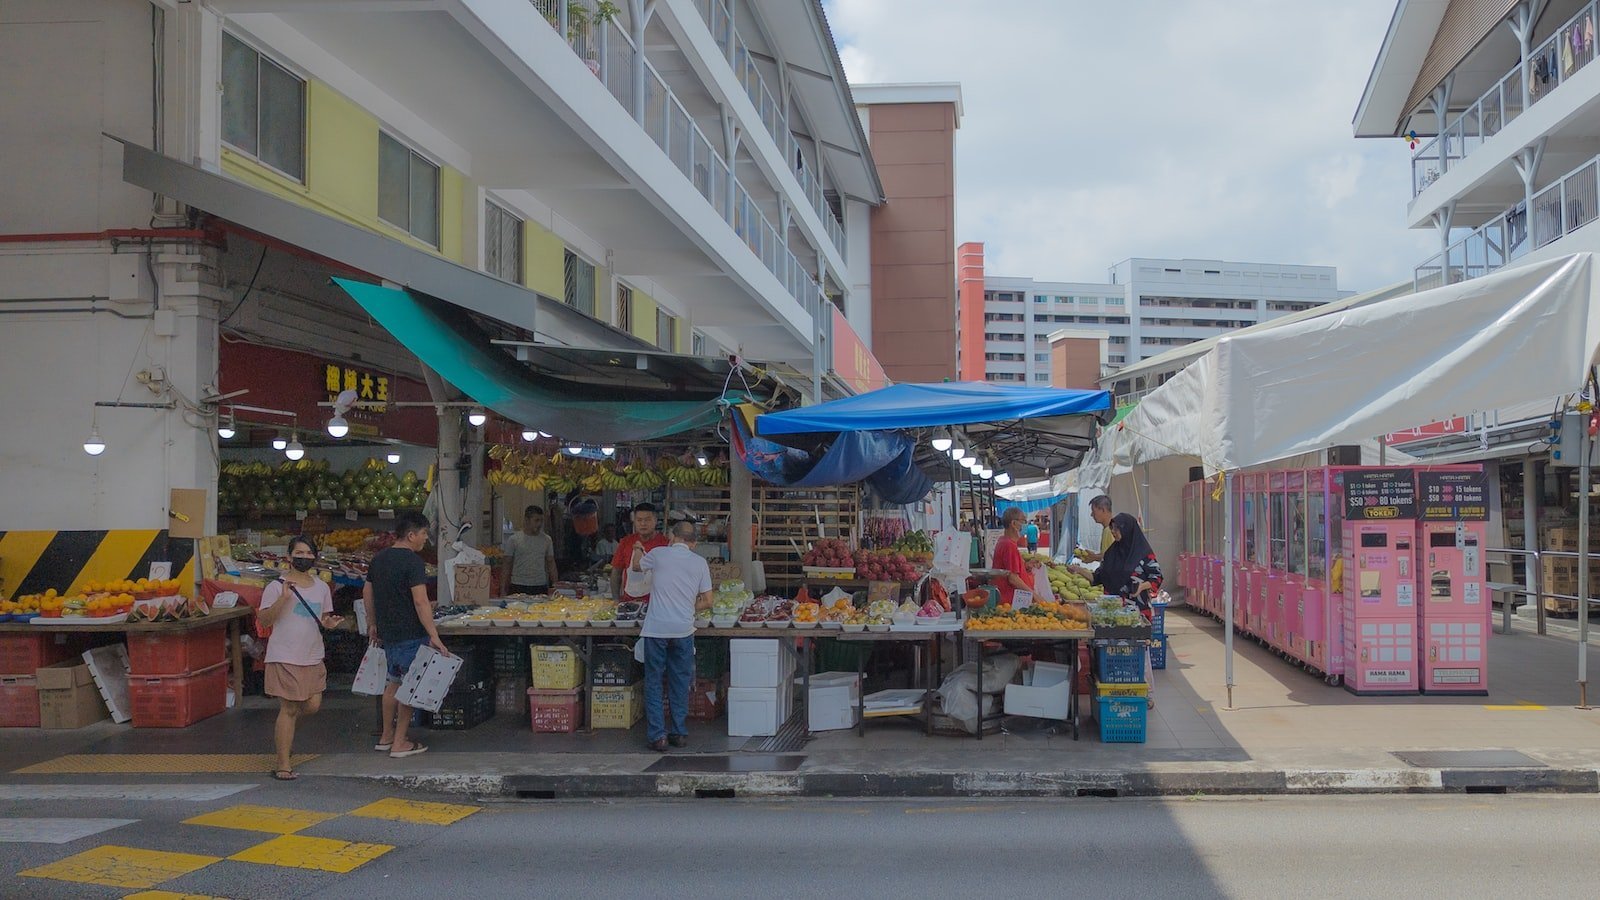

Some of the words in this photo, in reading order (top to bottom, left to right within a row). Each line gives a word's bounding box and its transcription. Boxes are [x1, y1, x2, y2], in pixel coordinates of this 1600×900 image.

[1428, 485, 1439, 493] $10
[1455, 485, 1462, 493] 15
[1463, 485, 1482, 493] tokens
[1350, 497, 1363, 506] $50
[1379, 496, 1388, 505] 80
[1390, 495, 1413, 505] tokens
[1428, 494, 1439, 502] $50
[1455, 494, 1462, 502] 80
[1463, 494, 1482, 502] tokens
